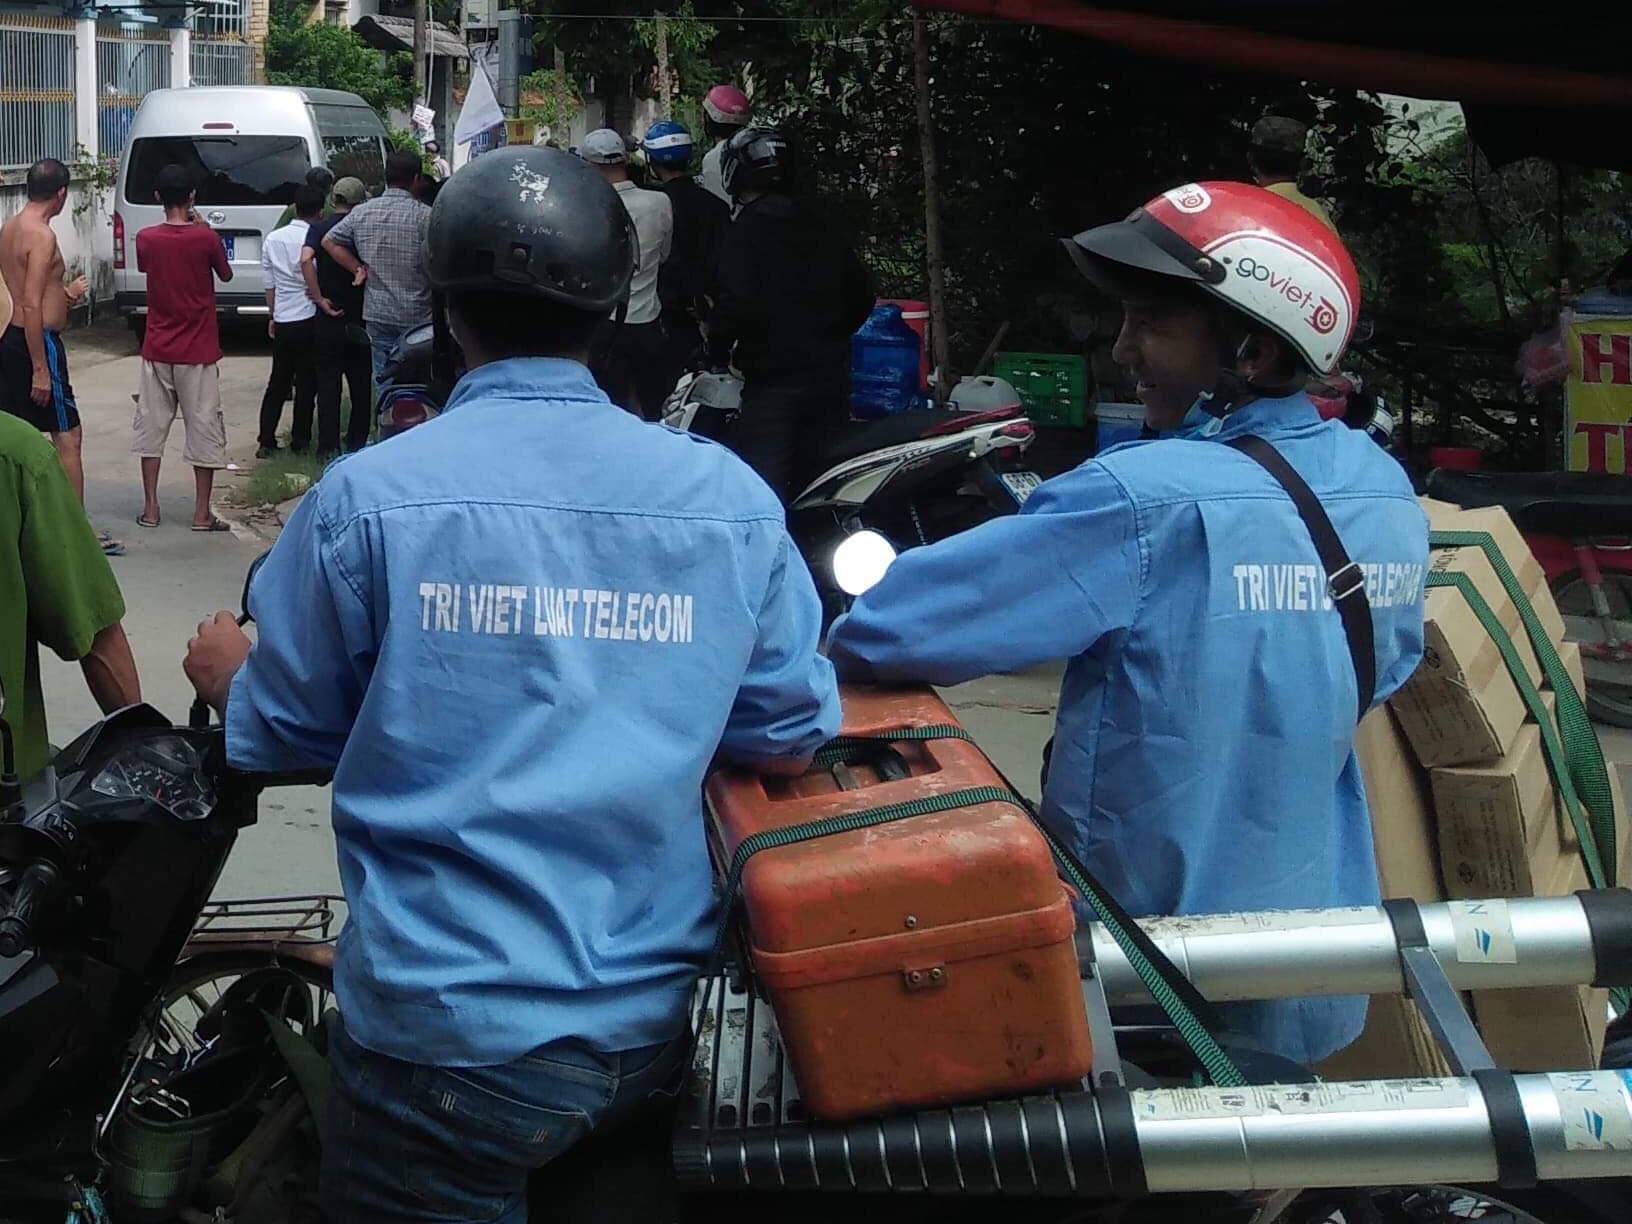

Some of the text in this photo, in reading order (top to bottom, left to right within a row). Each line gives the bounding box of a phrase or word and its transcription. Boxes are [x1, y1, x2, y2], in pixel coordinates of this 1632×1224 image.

[419, 583, 461, 632] TRI
[468, 584, 528, 635] VIET
[583, 589, 694, 644] TELECOM
[1233, 563, 1269, 610] TRI
[1274, 563, 1319, 611] VIET
